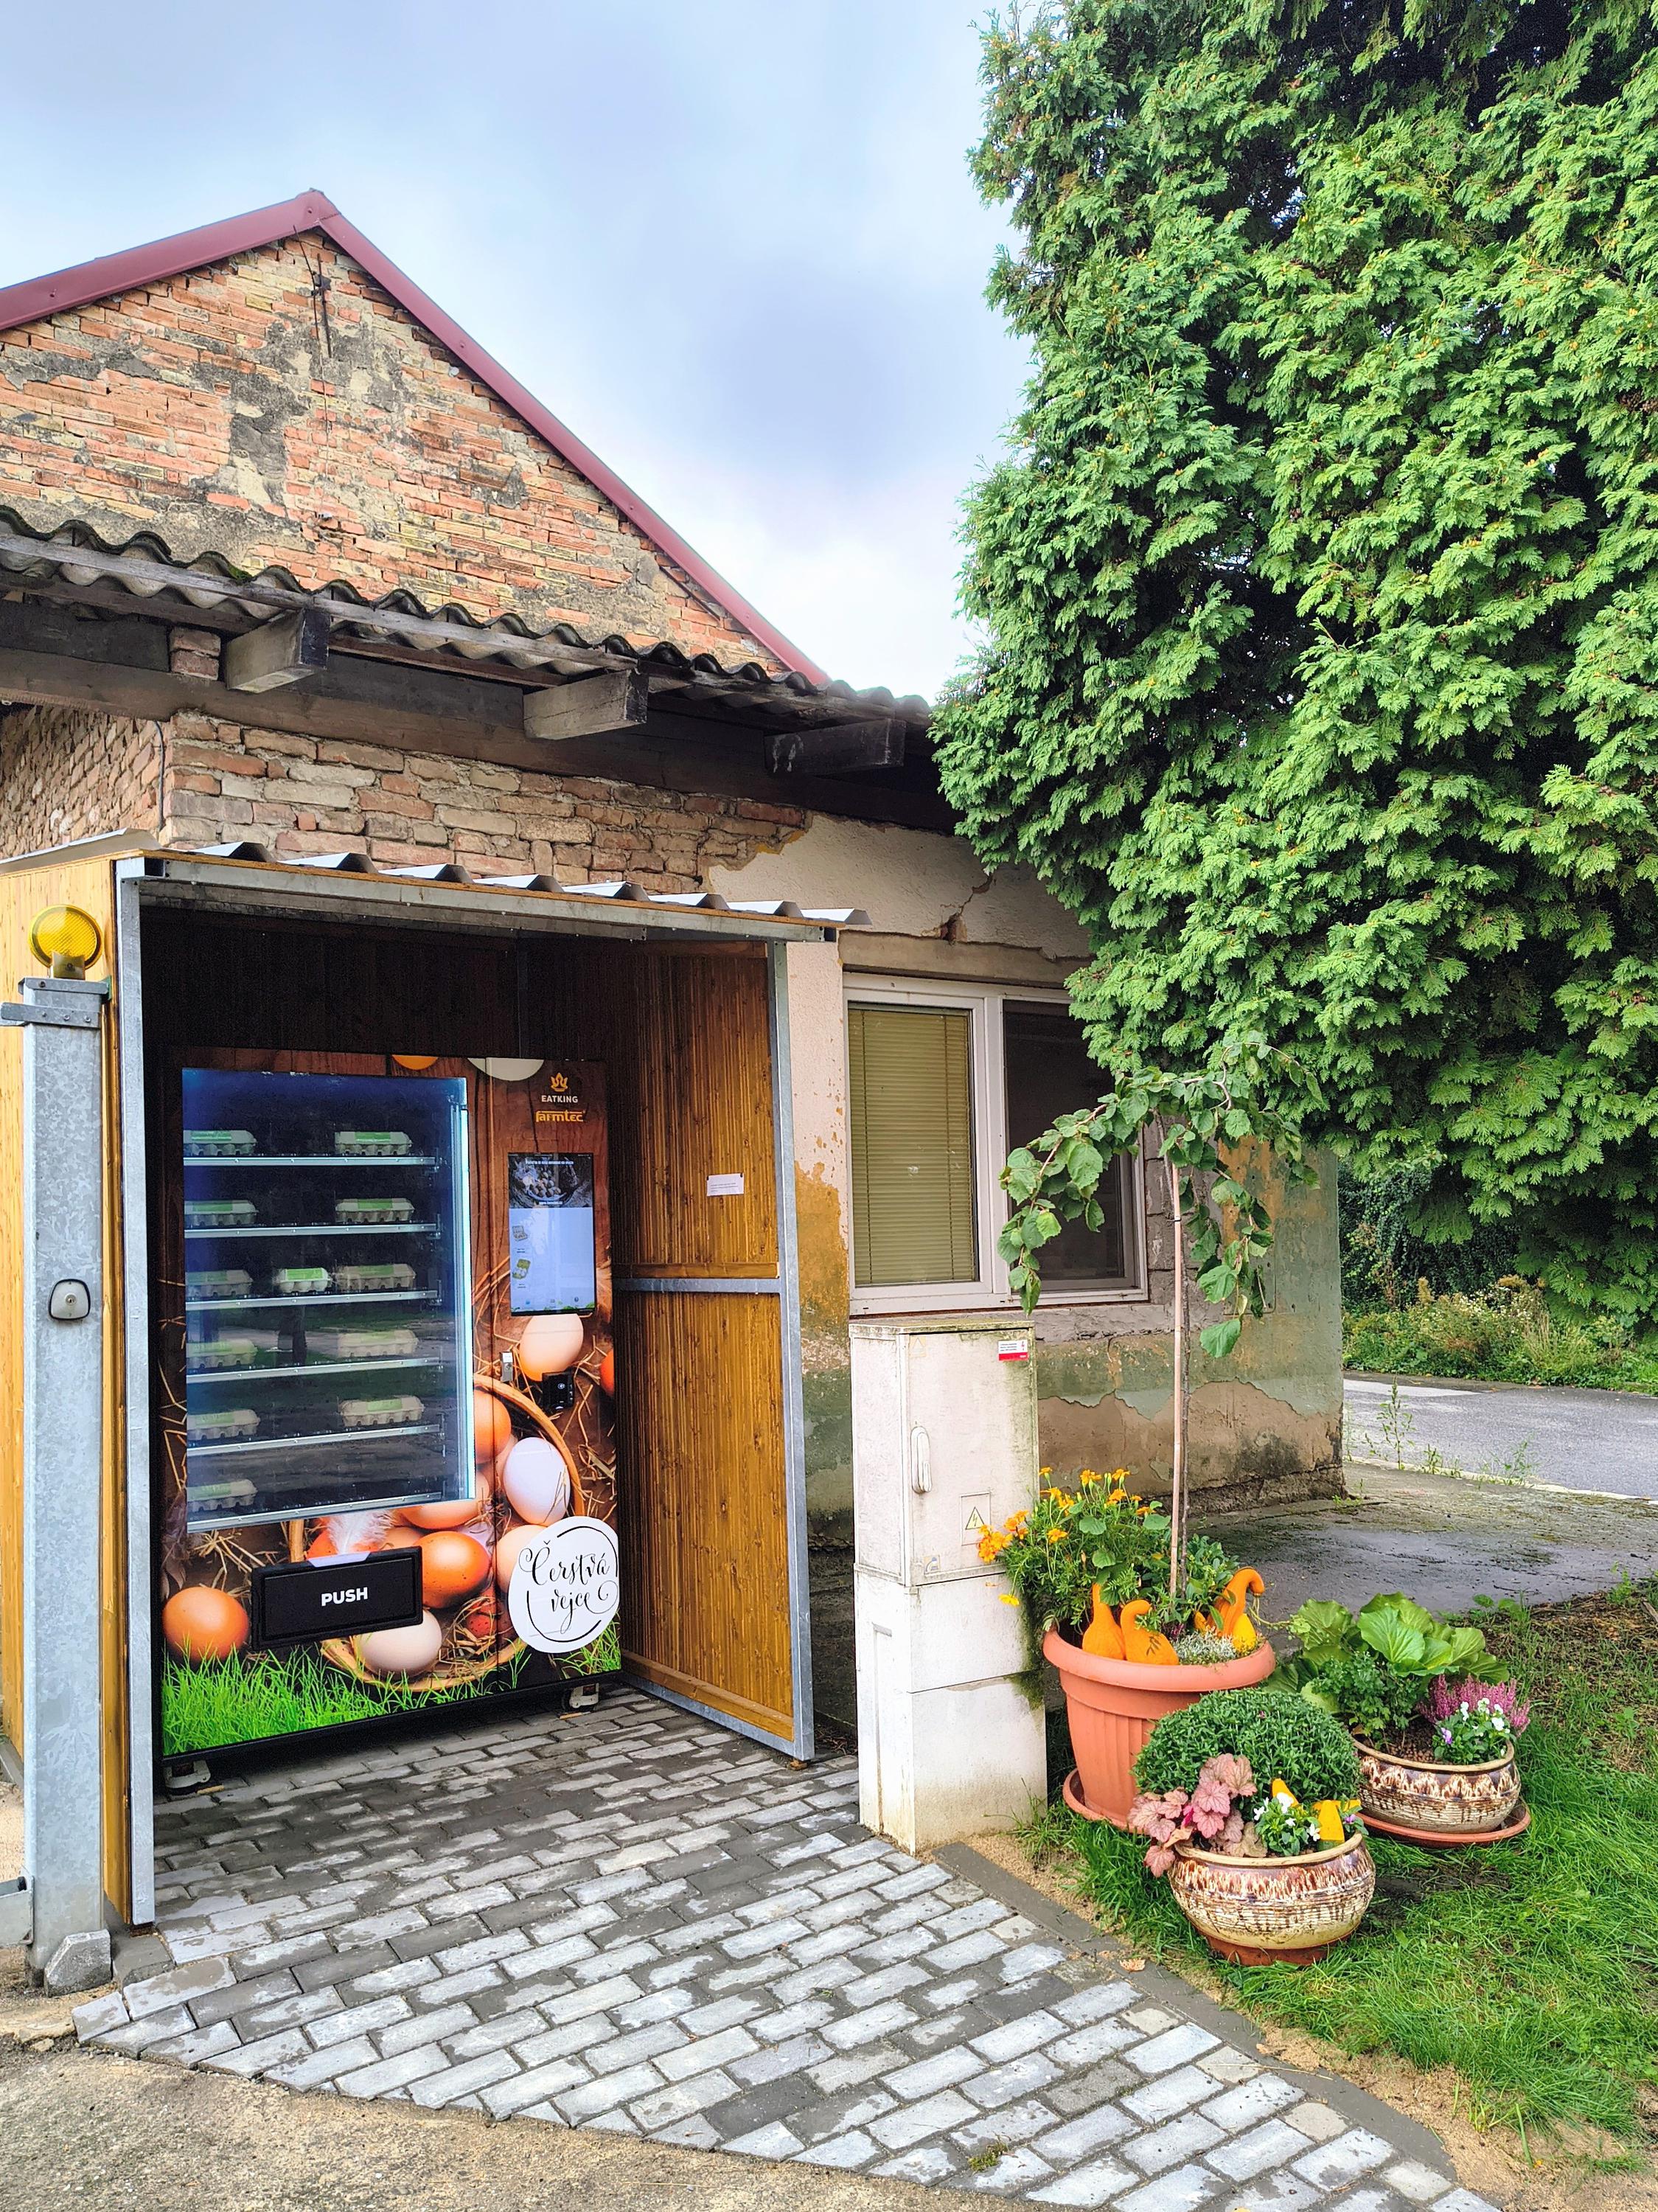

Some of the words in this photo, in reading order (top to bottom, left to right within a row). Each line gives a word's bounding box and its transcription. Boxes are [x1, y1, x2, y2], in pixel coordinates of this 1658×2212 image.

[541, 1095, 578, 1103] EATKING
[535, 1110, 584, 1122] farmtec
[518, 1540, 610, 1585] Čerstvá
[321, 1587, 368, 1607] PUSH
[551, 1581, 618, 1635] vejce
